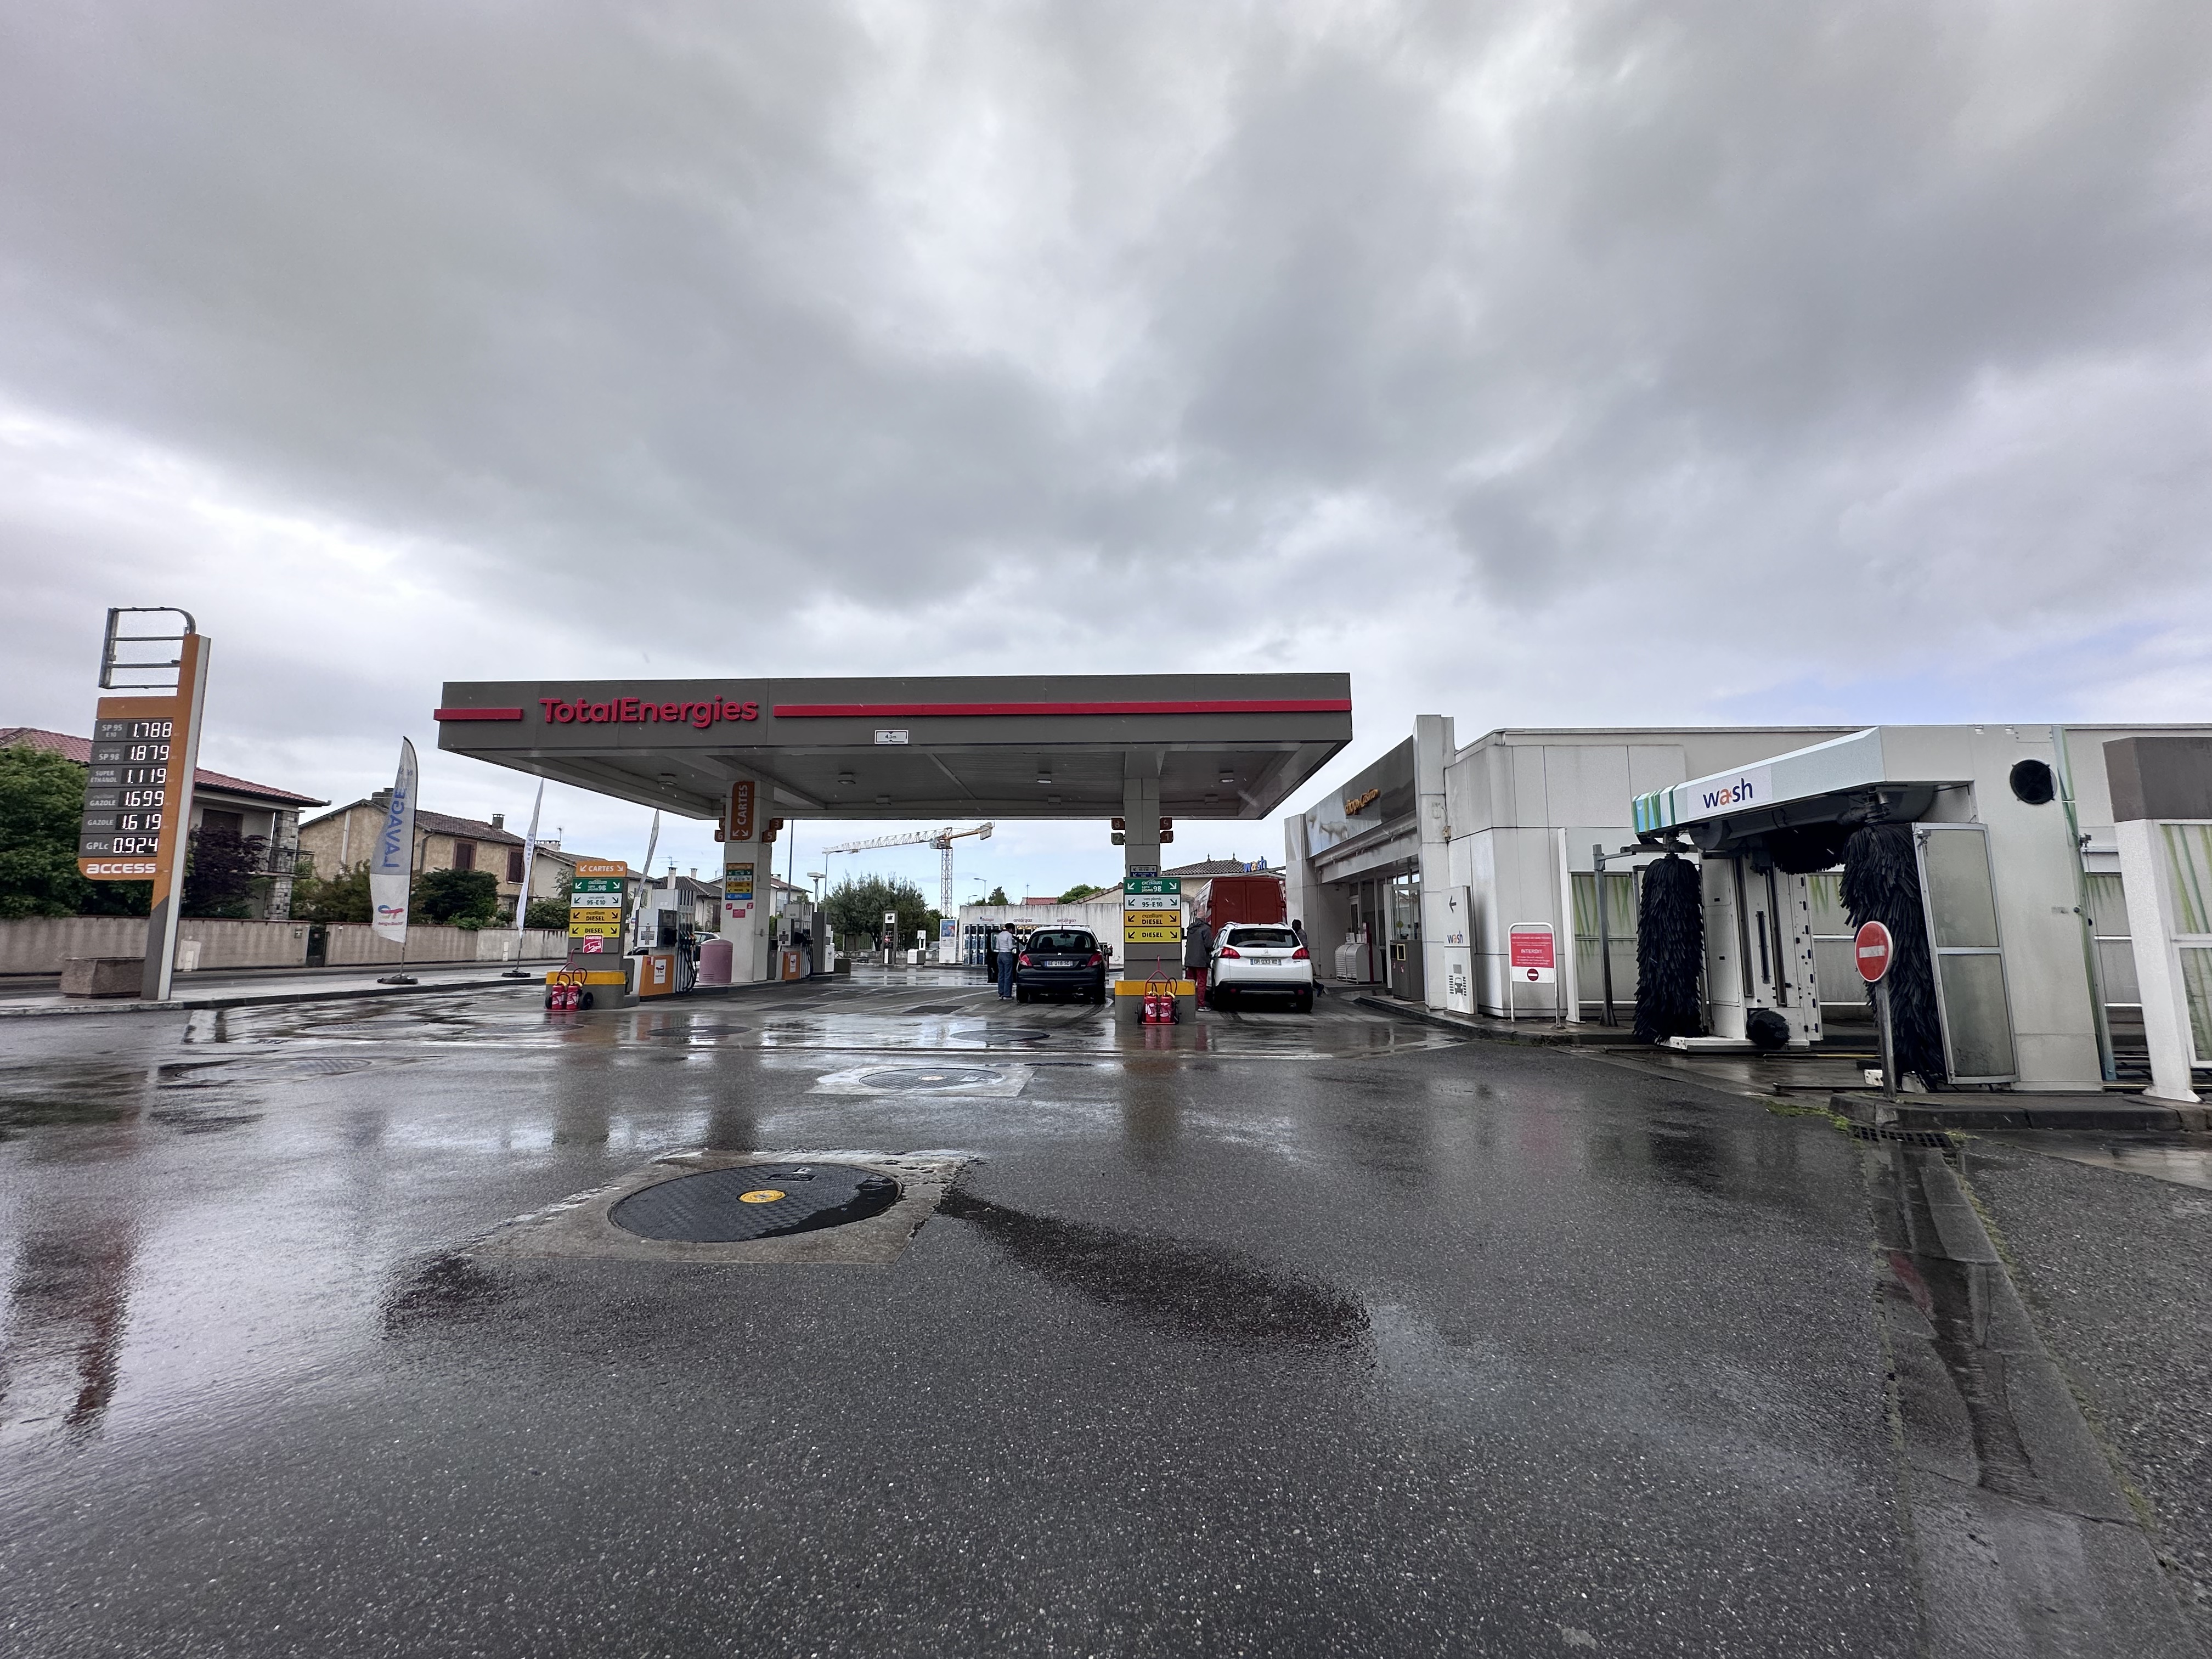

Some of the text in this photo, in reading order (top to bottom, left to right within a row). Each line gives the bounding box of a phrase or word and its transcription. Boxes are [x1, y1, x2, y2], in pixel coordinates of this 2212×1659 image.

[539, 695, 758, 728] TotalEnergies
[133, 722, 172, 737] 1.788
[131, 746, 170, 760] 1.879
[127, 768, 166, 784] 1.119
[125, 791, 165, 806] 1.699
[1703, 777, 1753, 809] wash
[737, 785, 748, 825] CARTES
[122, 814, 162, 830] 1.619
[113, 837, 159, 853] 0.924
[1114, 834, 1121, 843] 2
[1447, 930, 1463, 944] wash
